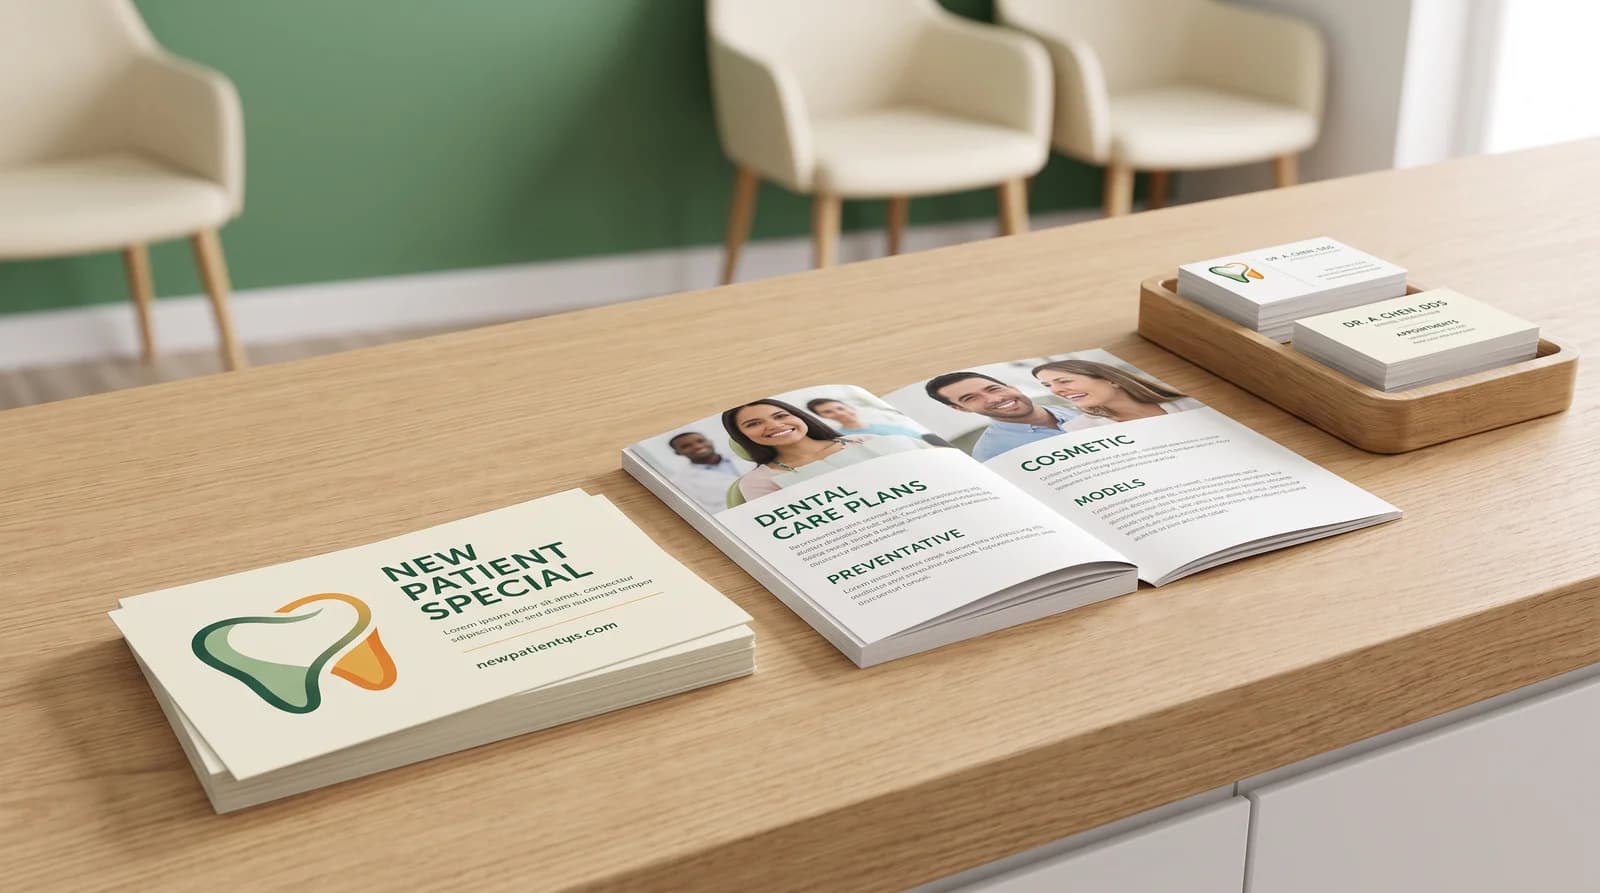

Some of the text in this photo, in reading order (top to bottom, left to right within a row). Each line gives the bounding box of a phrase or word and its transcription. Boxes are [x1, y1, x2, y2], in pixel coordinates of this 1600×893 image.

[1342, 318, 1369, 328] DR.
[1419, 299, 1448, 311] DDS
[1020, 434, 1136, 473] COSMETIC
[753, 485, 859, 528] DENTAL
[772, 507, 844, 541] CARE
[843, 479, 929, 514] PLANS
[1073, 478, 1146, 507] MODELS
[381, 543, 478, 583] NEW
[400, 541, 569, 602] PATIENT
[826, 528, 966, 585] PREVENTATIVE
[420, 562, 594, 621] SPECIAL
[524, 610, 544, 621] sed
[618, 579, 655, 593] tempor
[443, 621, 478, 636] Lorem
[479, 612, 511, 626] ipsum
[511, 603, 539, 616] dolor
[540, 598, 554, 608] sit
